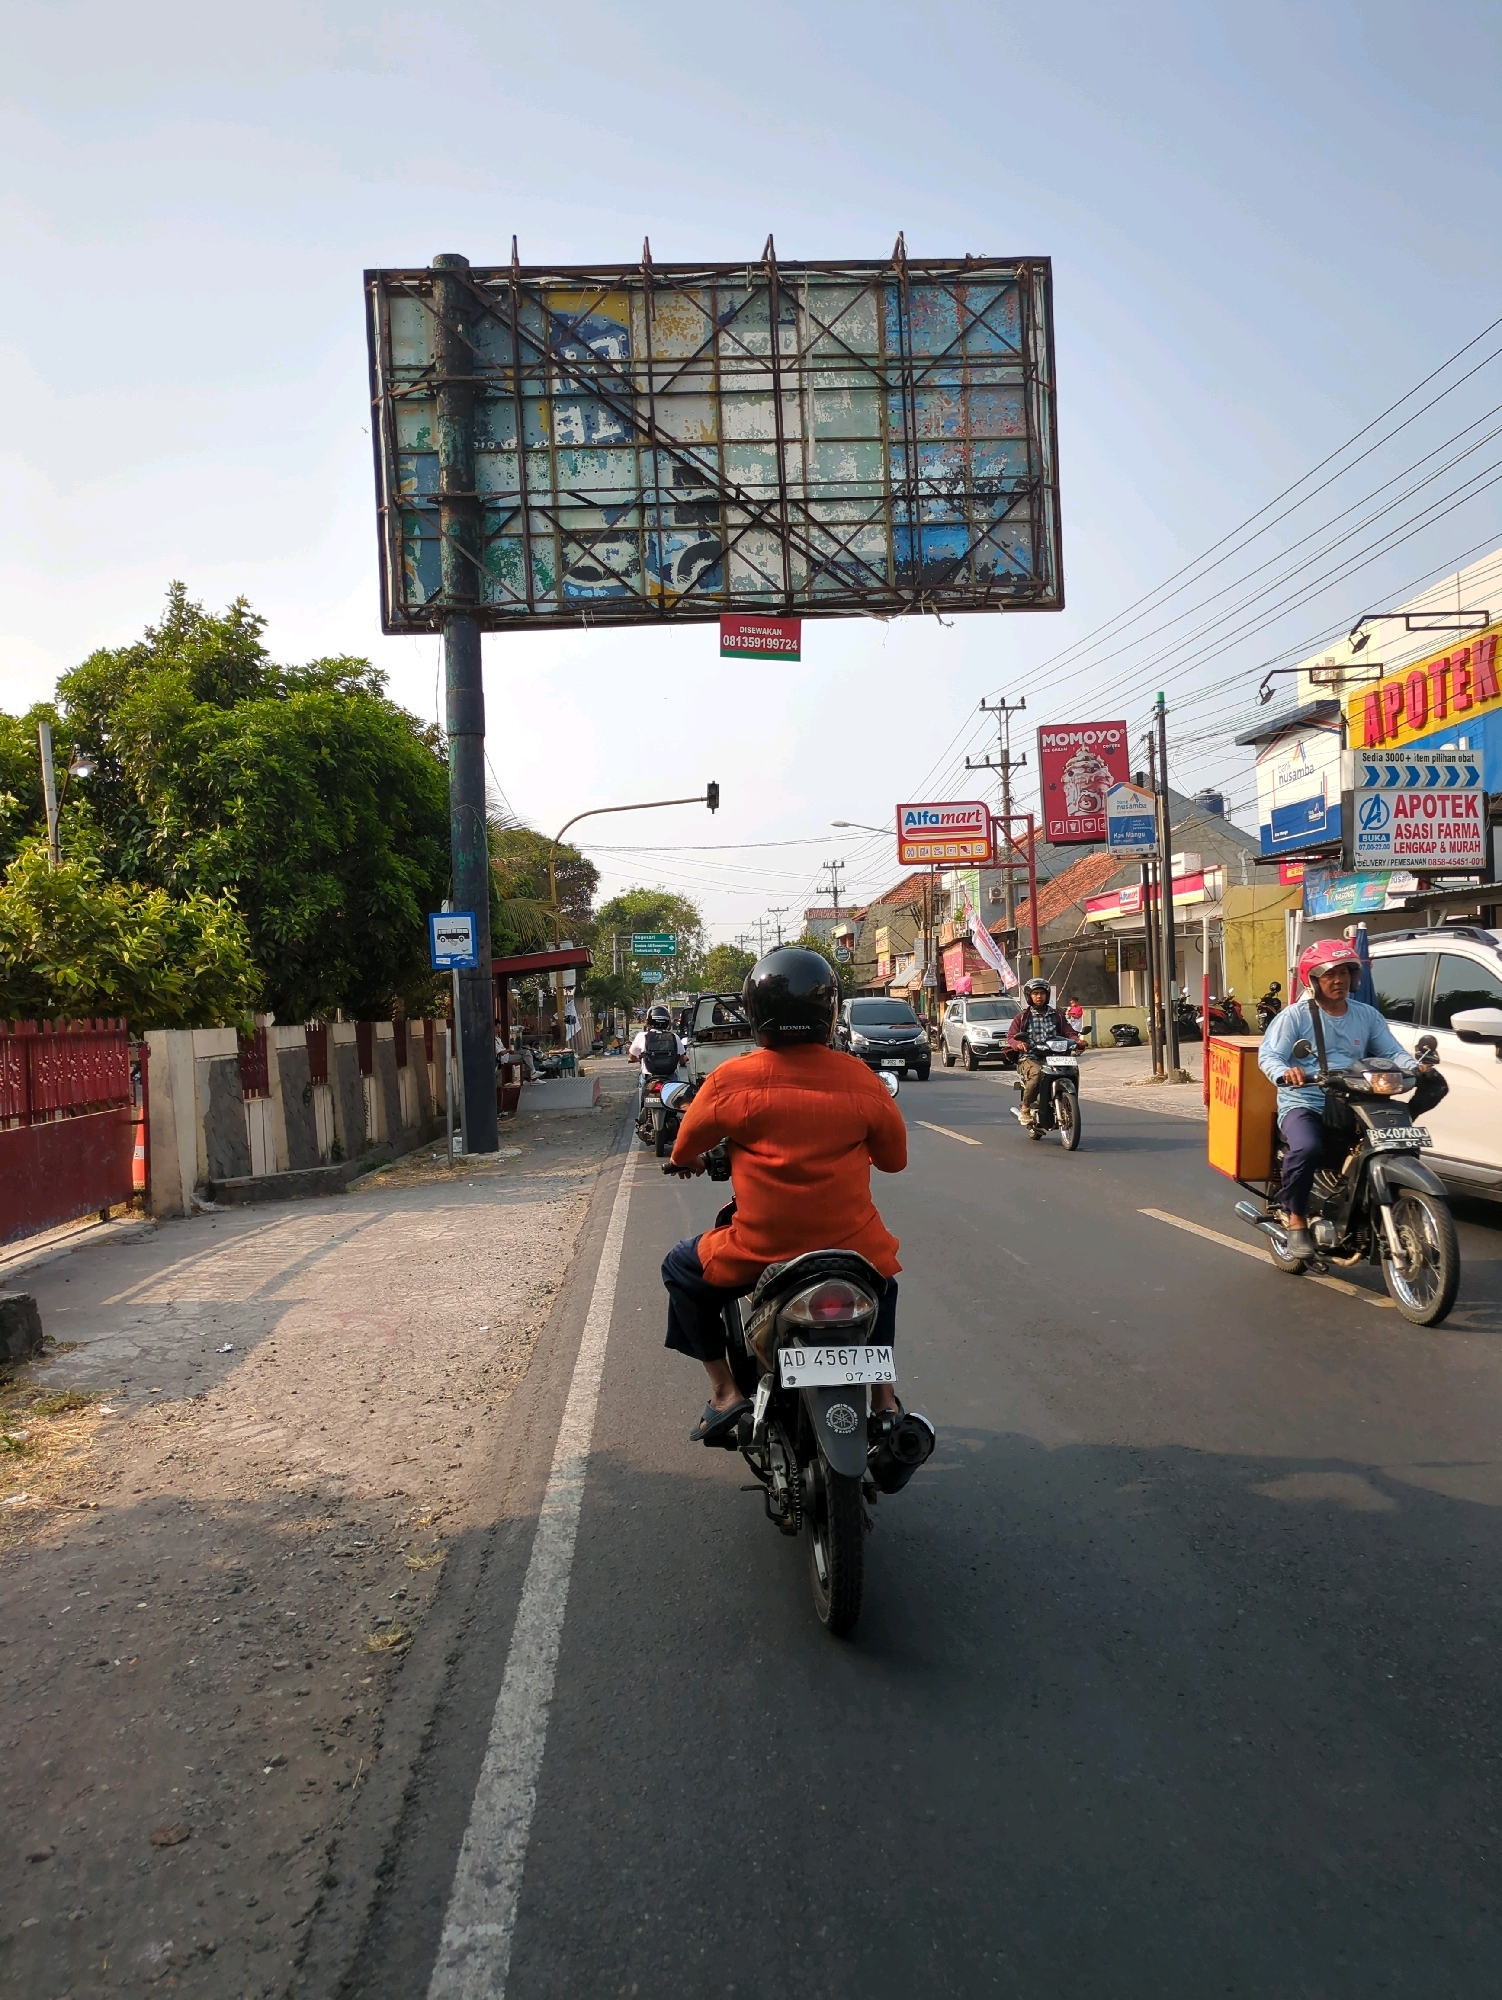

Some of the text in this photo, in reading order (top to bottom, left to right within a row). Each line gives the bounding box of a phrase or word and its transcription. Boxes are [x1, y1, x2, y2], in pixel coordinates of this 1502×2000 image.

[739, 626, 783, 635] DISEWAKAN
[723, 635, 798, 650] 081359199724
[1363, 634, 1501, 748] APOTEK
[1362, 752, 1475, 764] Sedia 3000+ item pilihan obat
[1278, 764, 1315, 785] nusamba
[1116, 801, 1147, 810] nusamba
[1393, 794, 1479, 819] APOTEK
[904, 809, 983, 826] Alfamart
[1362, 834, 1386, 842] BUKA
[1394, 822, 1480, 839] ASASI FARMA
[1394, 840, 1481, 854] LENGKAP & MURAH
[1390, 858, 1427, 866] PEMESANAN
[1427, 857, 1485, 867] 0858-45451-001
[783, 1348, 890, 1368] AD 4567 PM
